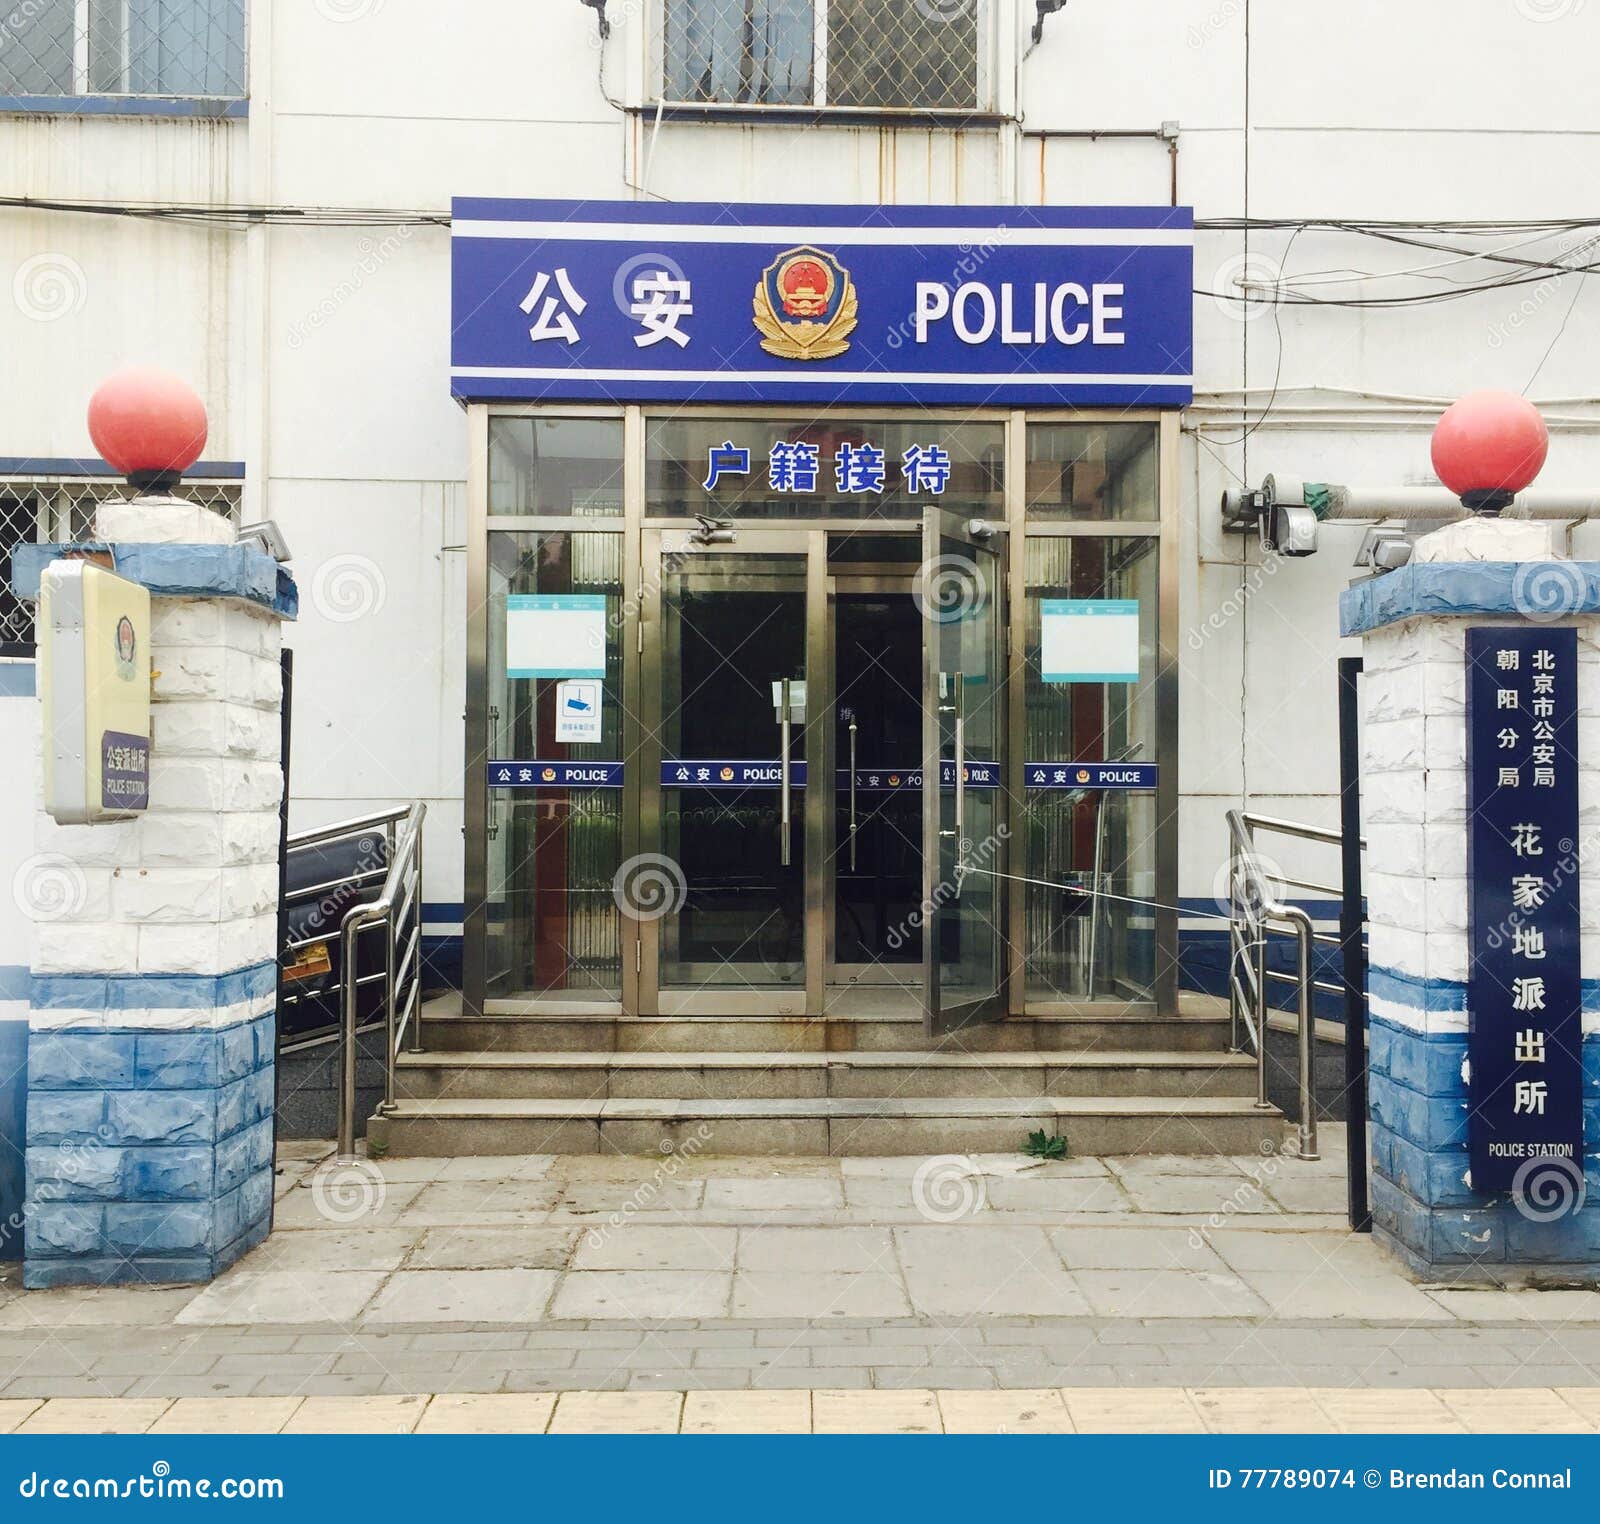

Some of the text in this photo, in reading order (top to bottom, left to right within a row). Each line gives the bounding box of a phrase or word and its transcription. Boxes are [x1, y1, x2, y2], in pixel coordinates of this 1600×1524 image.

[519, 268, 1126, 349] 公安 POLICE
[703, 440, 952, 496] 户籍接待
[1496, 650, 1521, 788] 朝阳分局
[1532, 650, 1557, 788] 北京市公安局
[498, 769, 608, 782] 公安 POLICE
[676, 768, 711, 782] 公安
[972, 770, 989, 782] POLICE
[1034, 770, 1141, 784] 公安 POLICE
[107, 779, 145, 795] POLICE STATION
[1511, 823, 1549, 1116] 花家地派出所
[1489, 1144, 1574, 1158] POLICE STATION
